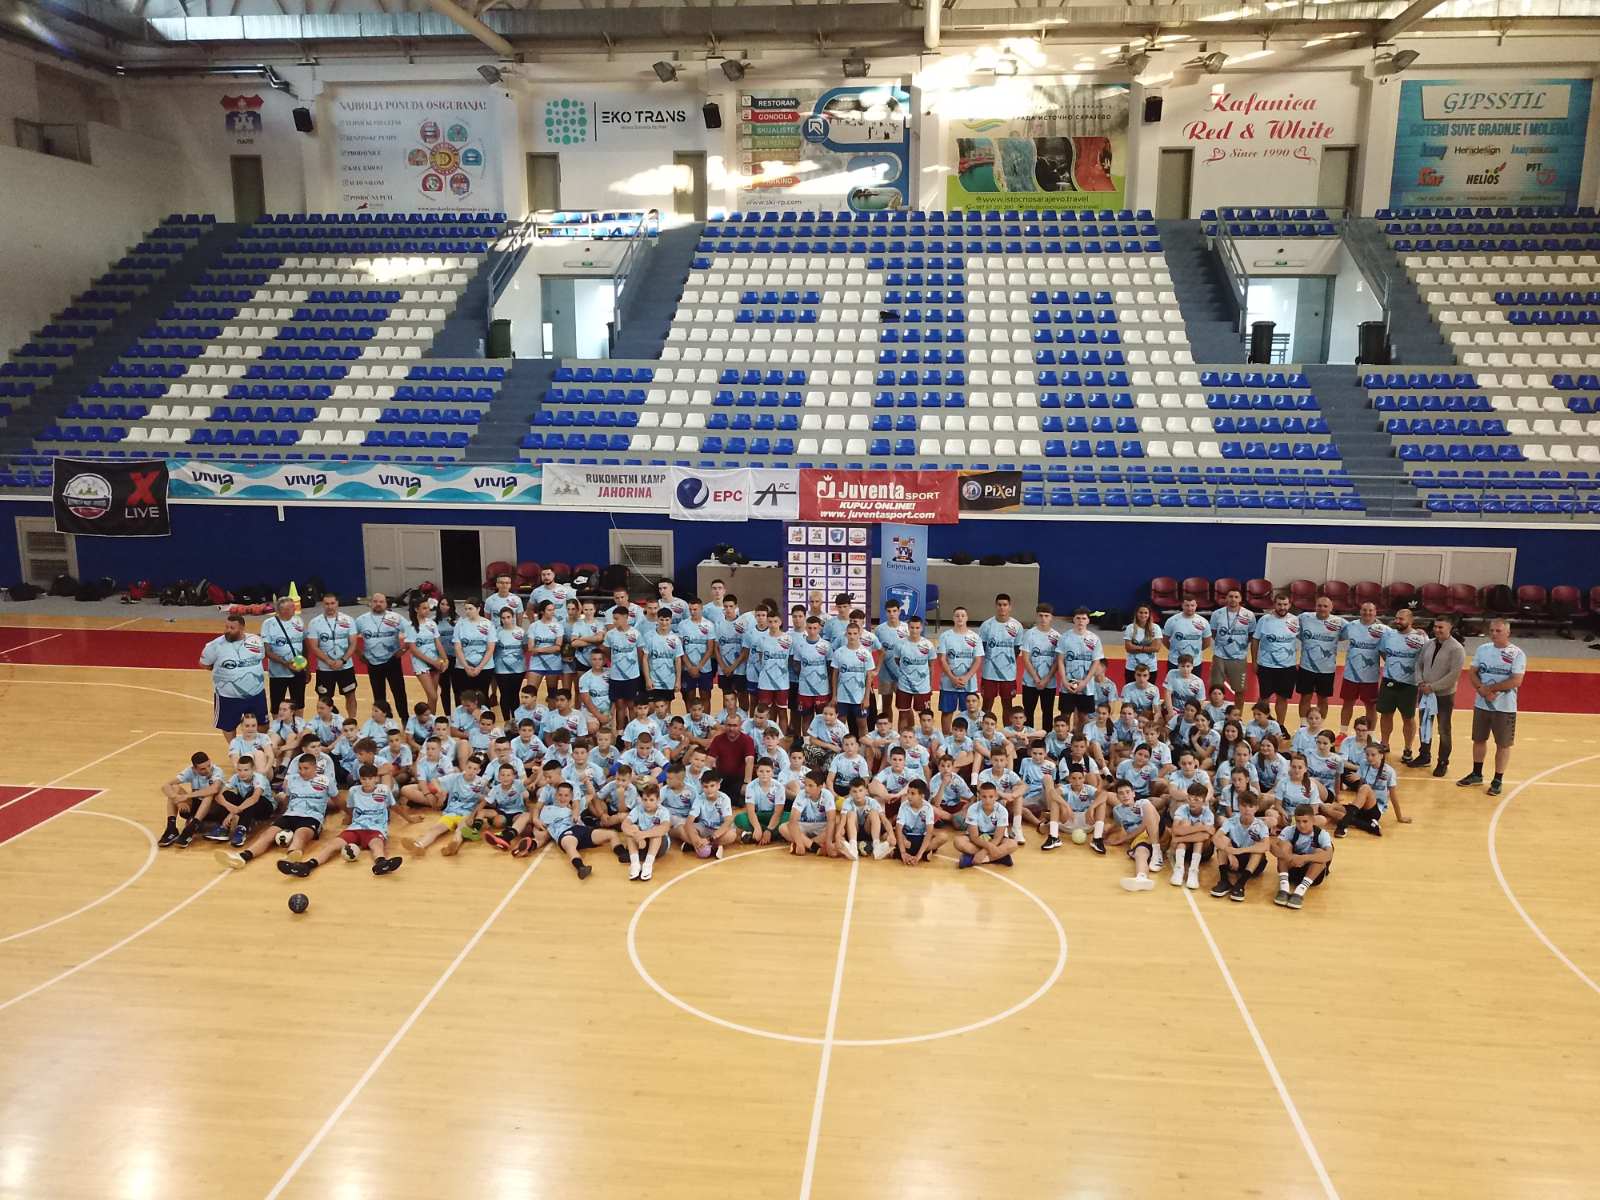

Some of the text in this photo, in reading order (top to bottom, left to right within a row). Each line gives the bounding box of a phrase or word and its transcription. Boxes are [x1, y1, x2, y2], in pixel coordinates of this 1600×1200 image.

[385, 101, 424, 110] PONUDA
[426, 101, 488, 111] OSIGURANJA!
[758, 99, 796, 107] RESTORAN
[1204, 92, 1317, 115] Kafanica
[1443, 91, 1547, 114] GIPSSTIL
[601, 110, 686, 123] EKO TRANS
[1182, 120, 1334, 140] Red & White
[1450, 123, 1476, 136] SUVE
[1477, 123, 1521, 136] GRADNJE
[1229, 148, 1290, 158] Since 1990
[585, 473, 666, 485] RUKOMETNI KAMP
[127, 471, 160, 505] X
[597, 486, 653, 499] JAHORINA
[838, 480, 941, 501] Juventa SPORT
[713, 490, 743, 502] EPC
[125, 506, 160, 518] LIVE
[839, 502, 916, 510] KUPUJ ONLINE!
